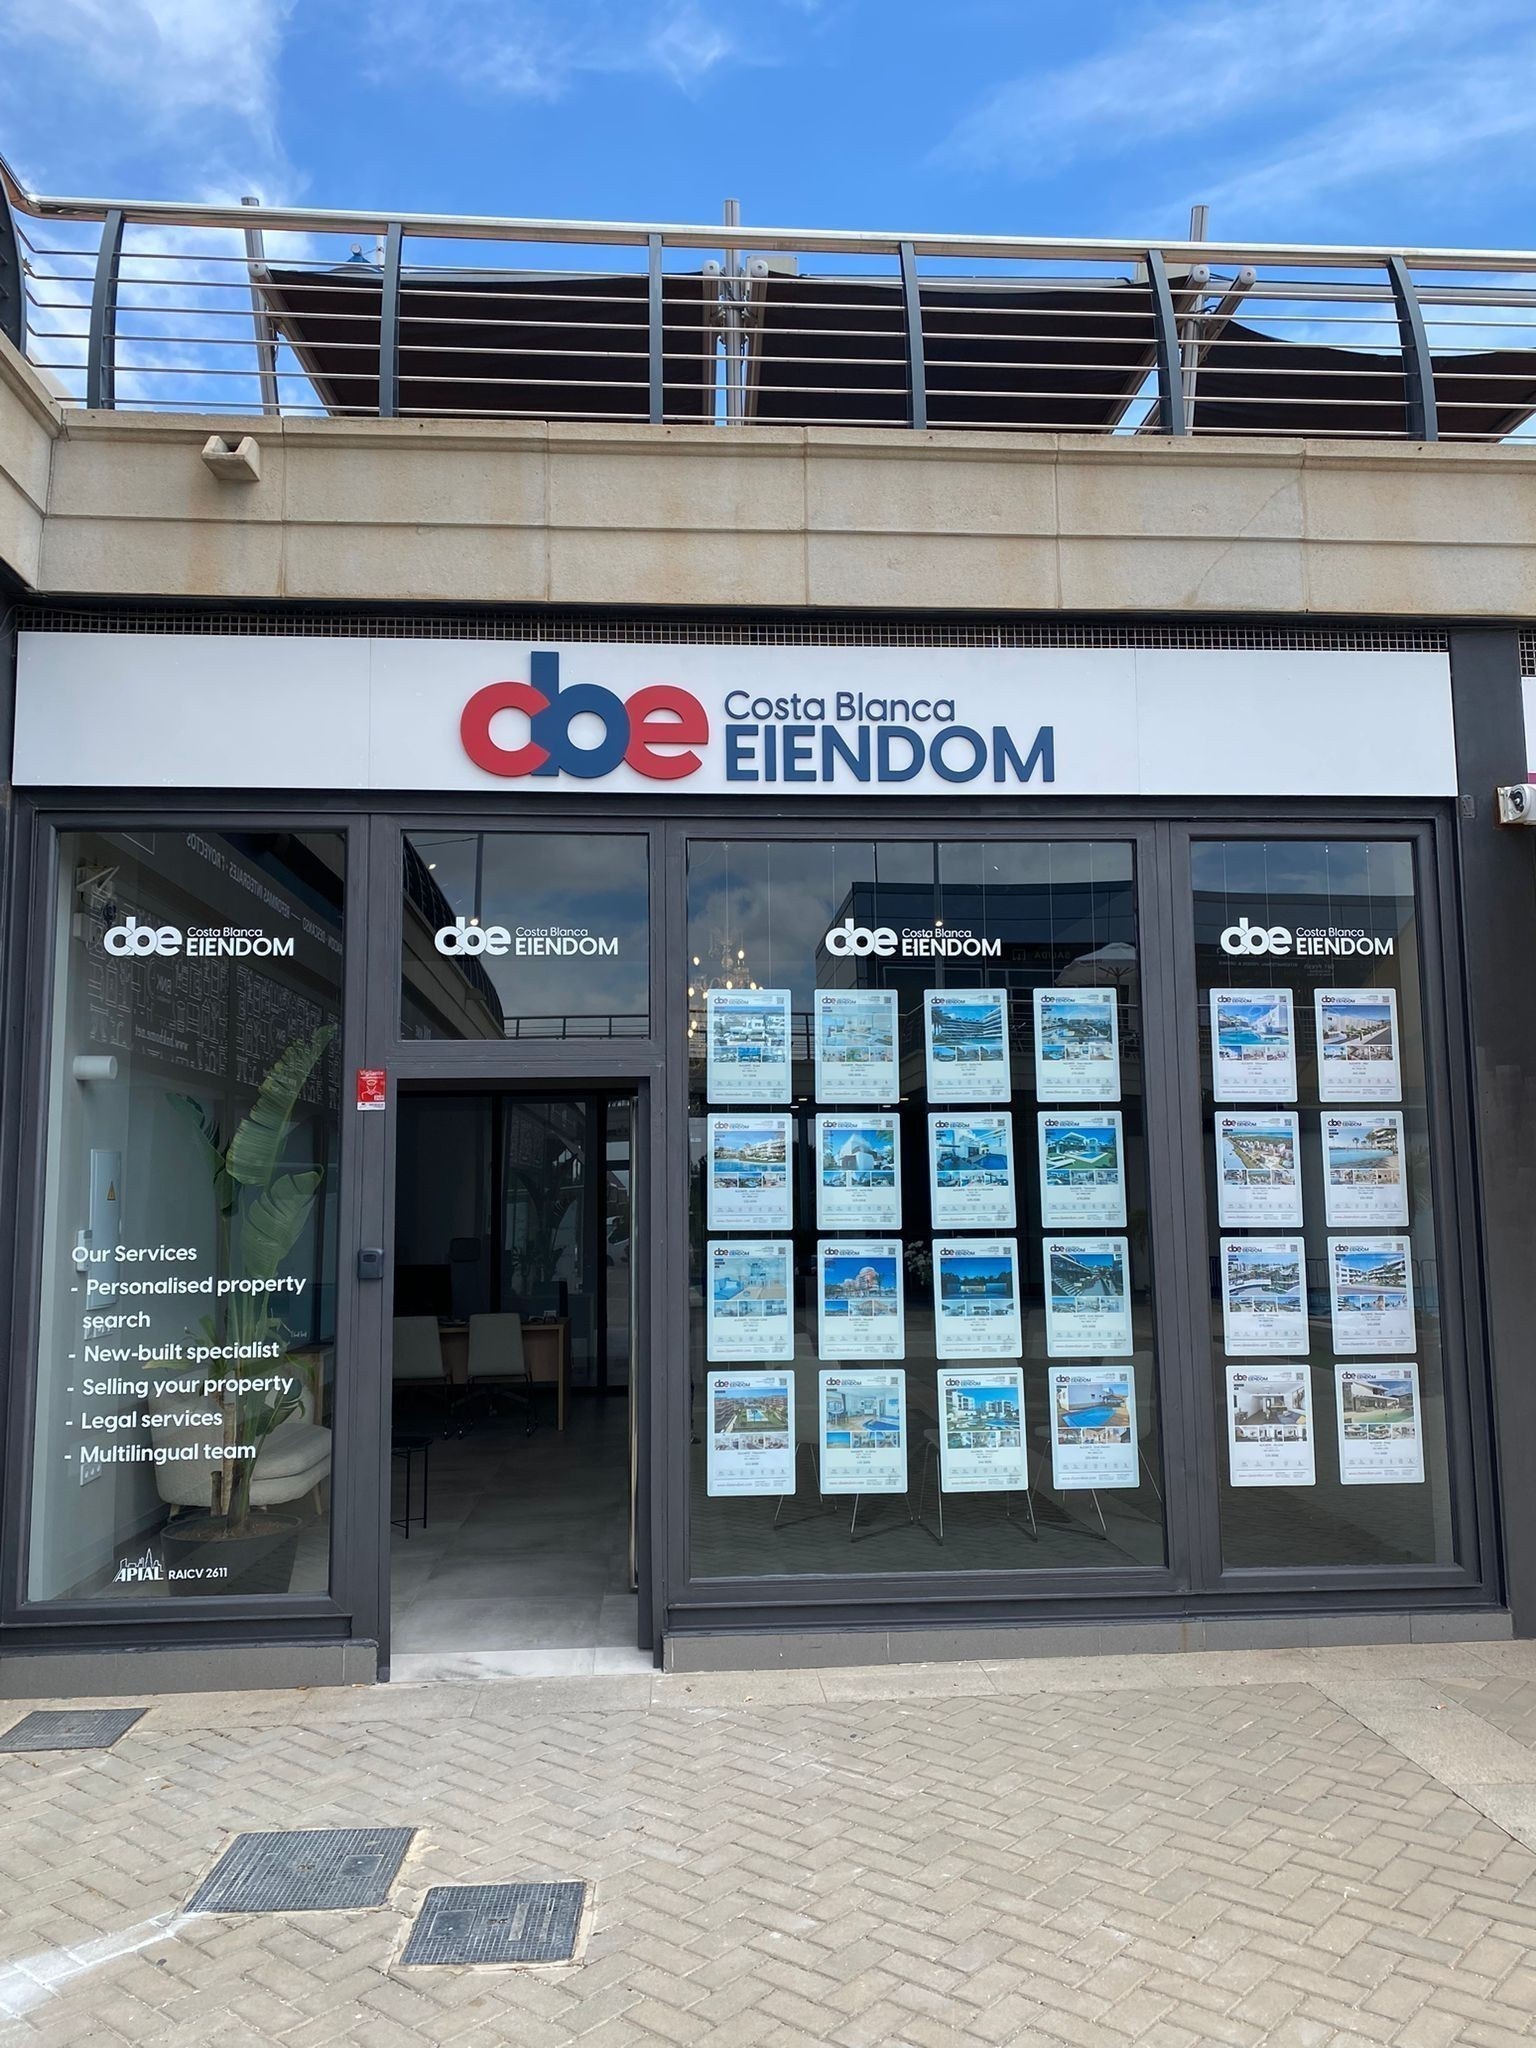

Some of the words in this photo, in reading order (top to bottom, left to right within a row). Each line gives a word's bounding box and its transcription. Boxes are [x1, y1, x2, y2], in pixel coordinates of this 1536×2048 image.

[724, 690, 824, 722] Costa
[836, 691, 956, 722] Blanca
[725, 724, 1055, 783] EIENDOM
[187, 927, 220, 937] Costa
[223, 927, 263, 937] Blanca
[515, 926, 547, 937] Costa
[550, 927, 588, 938] Blanca
[902, 928, 932, 938] Costa
[935, 928, 972, 938] Blanca
[1296, 927, 1326, 937] Costa
[1329, 927, 1365, 937] Blanca
[186, 937, 295, 957] EIENDOM
[515, 938, 619, 956] EIENDOM
[901, 938, 1002, 957] EIENDOM
[1296, 937, 1394, 956] EIENDOM
[71, 1246, 110, 1263] Our
[115, 1245, 197, 1262] Services
[86, 1277, 213, 1296] Personalised
[217, 1275, 307, 1297] property
[82, 1311, 151, 1329] search
[84, 1344, 183, 1362] New-built
[186, 1342, 280, 1363] specialist
[82, 1378, 149, 1398] Selling
[153, 1379, 199, 1397] your
[203, 1375, 294, 1397] property
[81, 1411, 137, 1433] Legal
[141, 1409, 223, 1427] services
[80, 1444, 198, 1465] Multilingual
[203, 1444, 256, 1460] team
[113, 1566, 164, 1582] APIAL
[168, 1567, 204, 1580] RAICV
[205, 1567, 228, 1578] 2611
